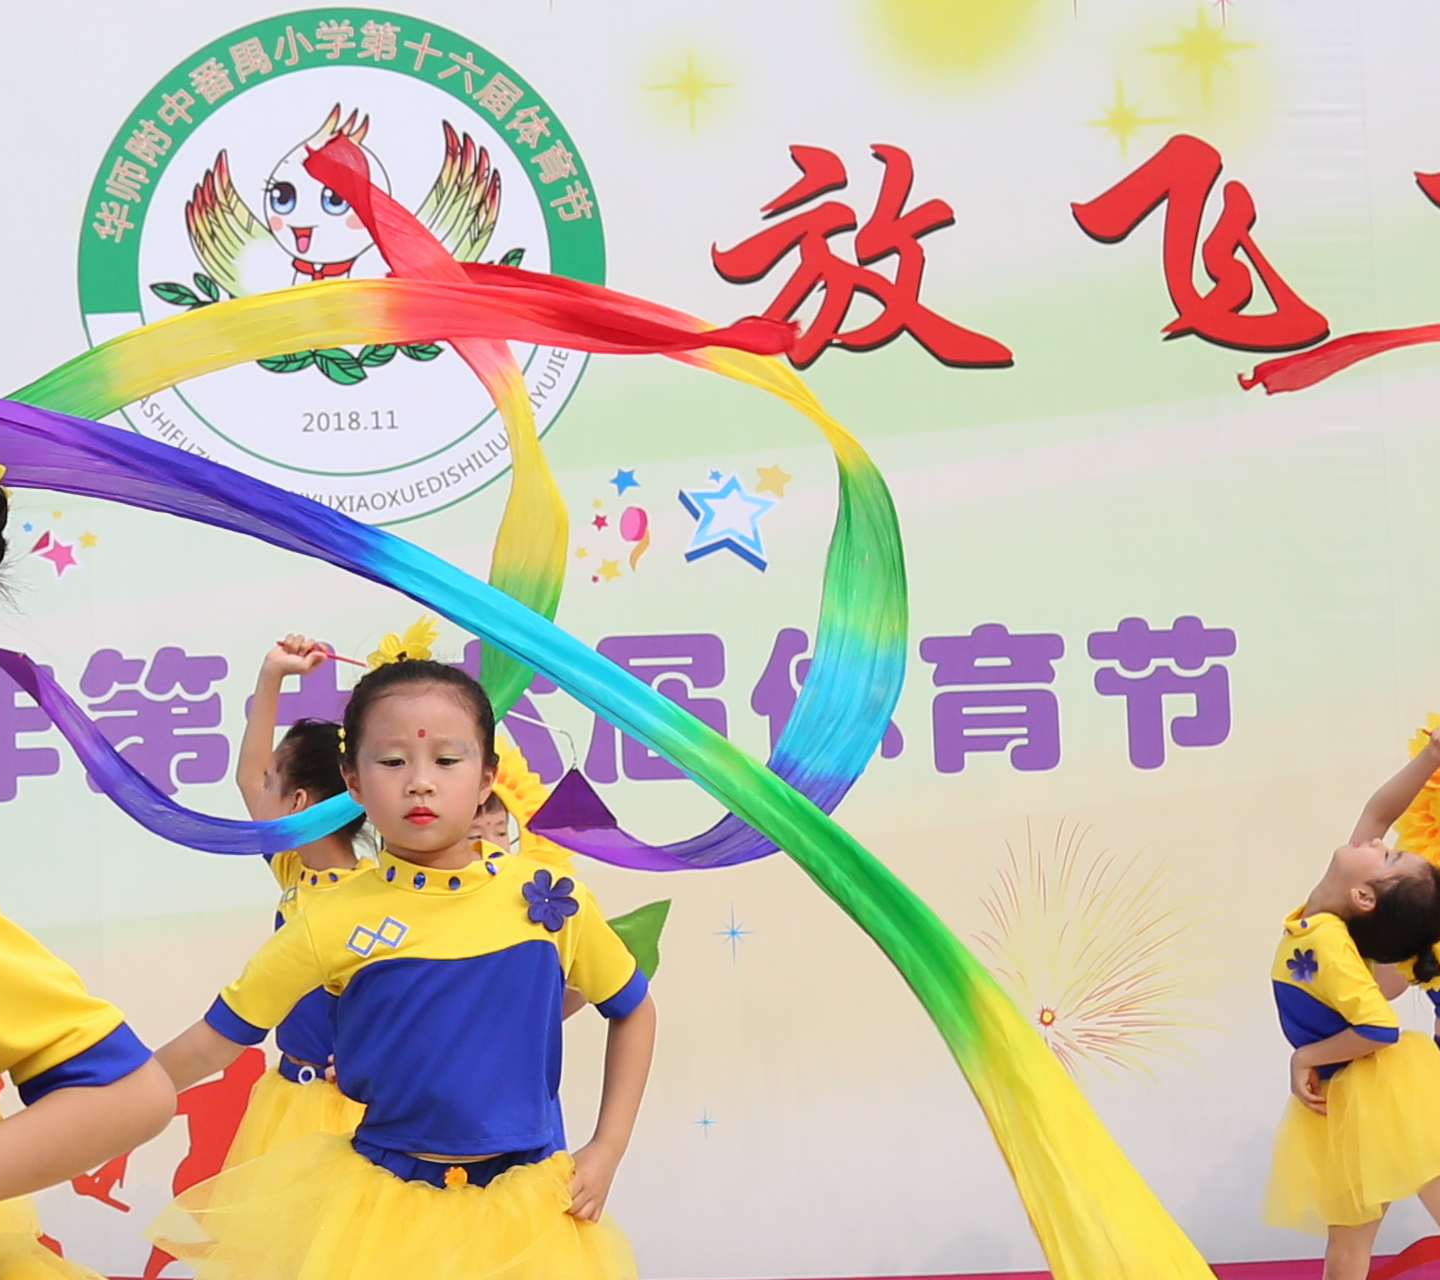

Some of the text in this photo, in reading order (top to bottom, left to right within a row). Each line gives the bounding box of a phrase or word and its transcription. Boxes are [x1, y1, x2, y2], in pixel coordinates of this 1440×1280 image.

[92, 20, 596, 244] 华师附中番禺小学第十六届体育节
[301, 409, 399, 433] 2018.11
